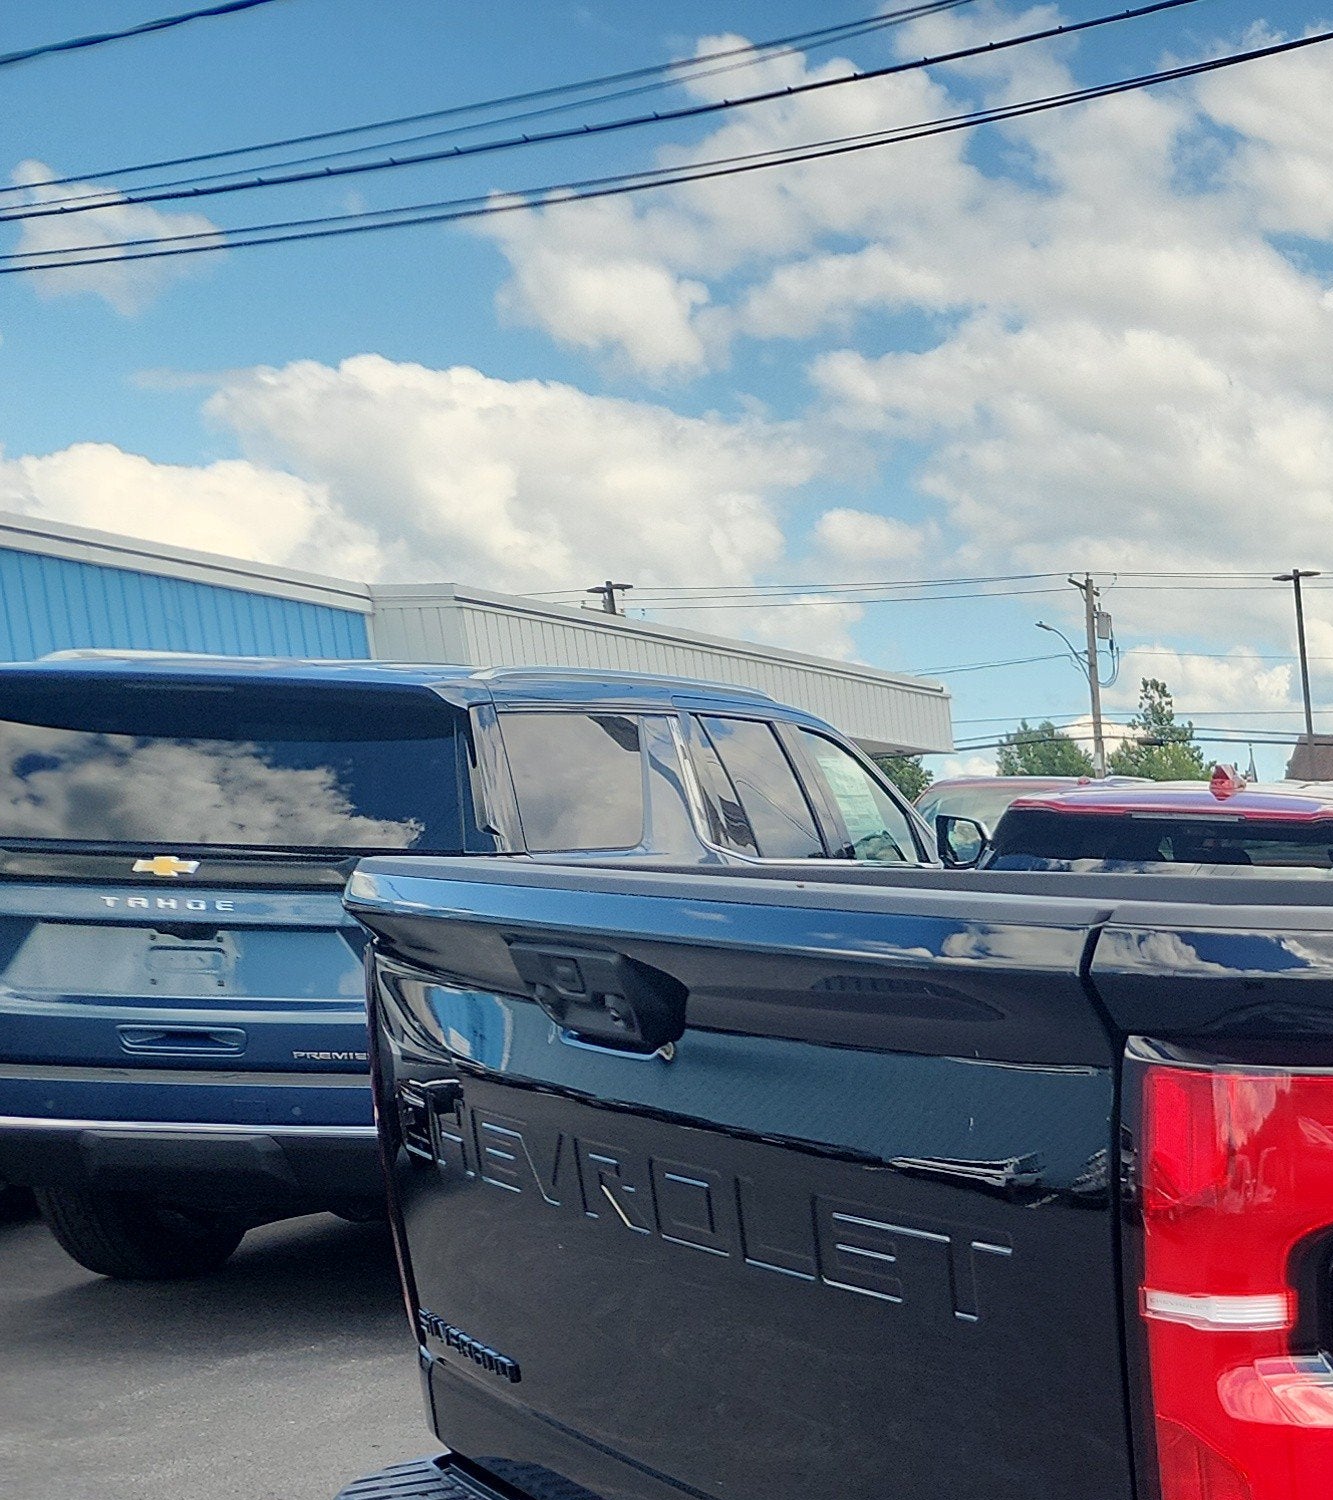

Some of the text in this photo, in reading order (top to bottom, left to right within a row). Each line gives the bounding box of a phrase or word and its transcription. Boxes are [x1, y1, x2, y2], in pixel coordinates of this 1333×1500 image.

[100, 896, 235, 912] TAHOE
[292, 1050, 370, 1061] PREMIE
[398, 1085, 1013, 1323] CHEVROLET
